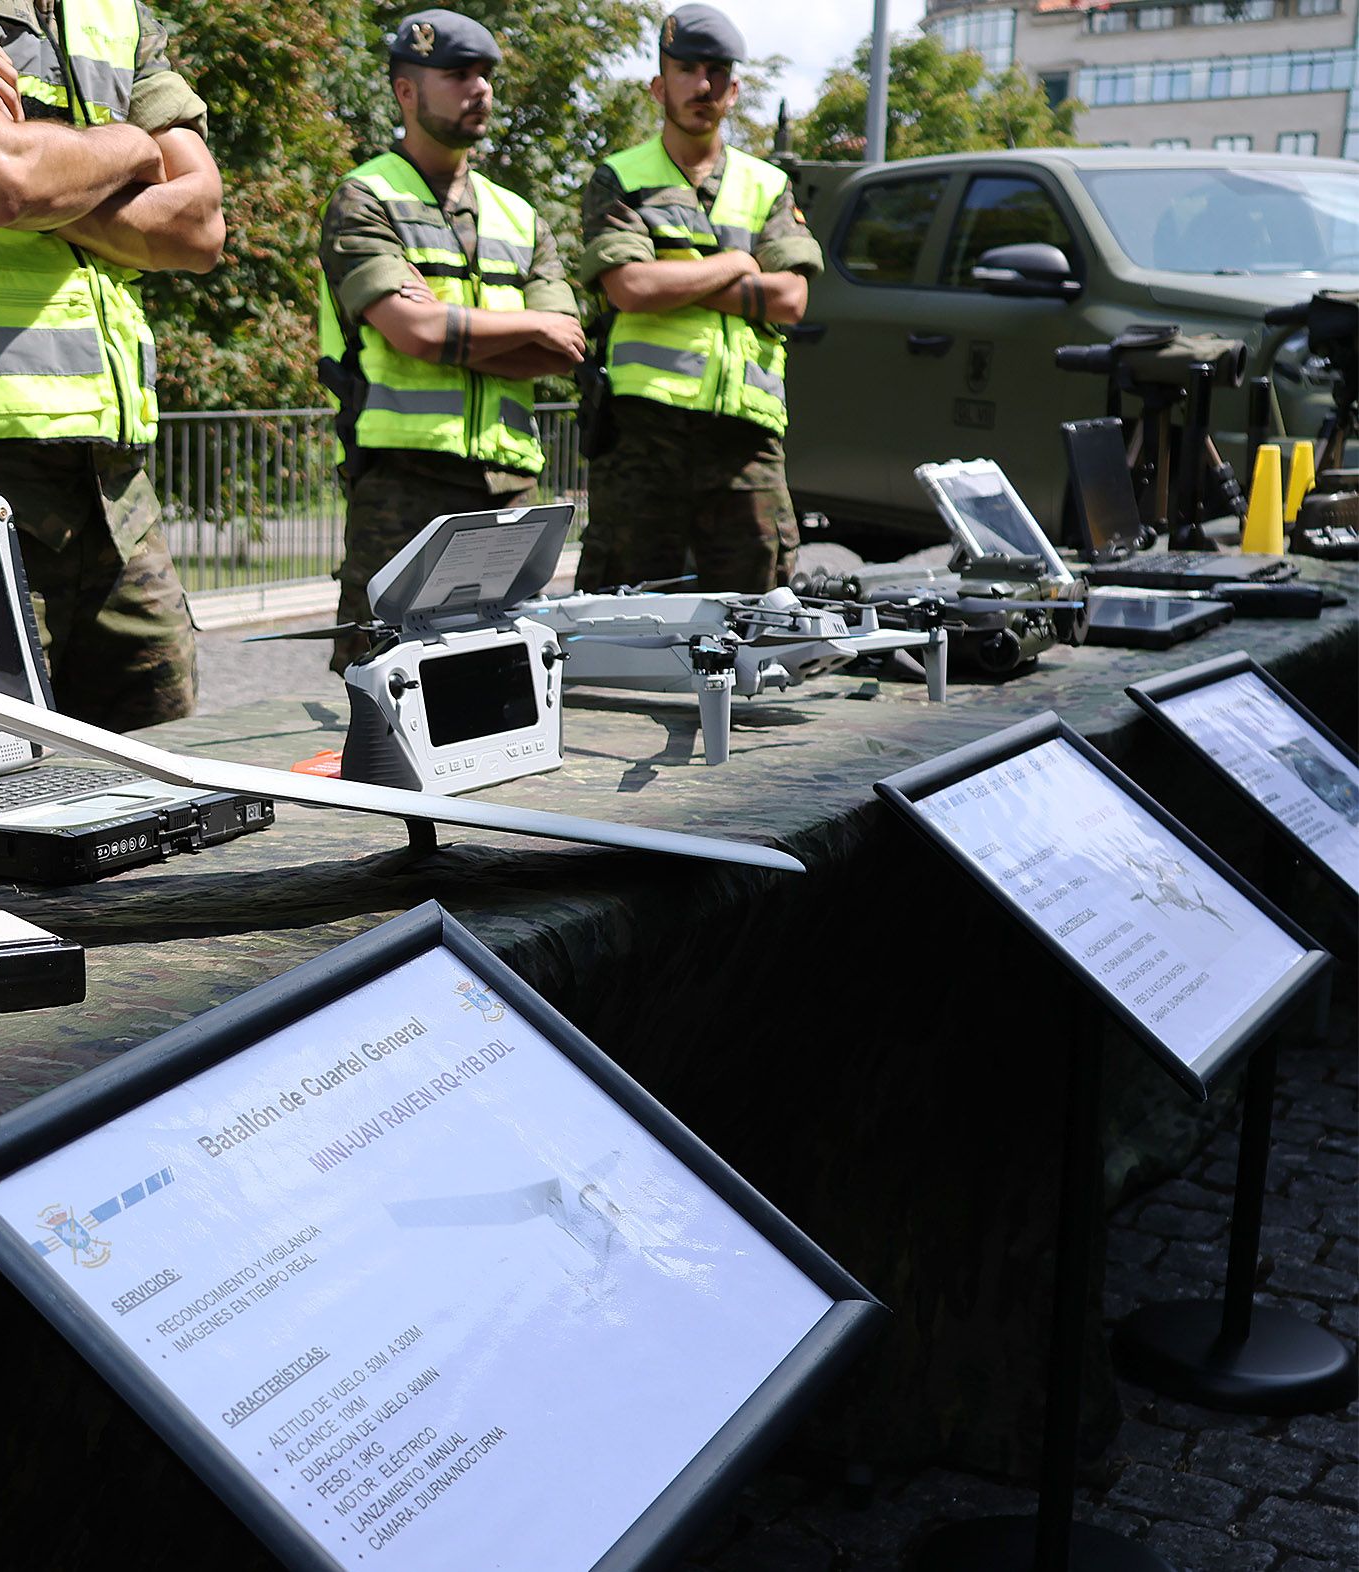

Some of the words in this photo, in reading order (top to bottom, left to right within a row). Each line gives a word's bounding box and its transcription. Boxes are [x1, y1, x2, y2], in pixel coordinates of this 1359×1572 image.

[966, 777, 1002, 799] Bataón
[197, 1108, 283, 1158] Batallón
[279, 1091, 307, 1113] de
[300, 1051, 369, 1097] Cuartel
[361, 1016, 428, 1062] General
[308, 1117, 385, 1174] MINI-UAV
[378, 1086, 438, 1129] RAVEN
[429, 1055, 486, 1096] RQ-11B
[478, 1038, 516, 1065] DDL
[111, 1268, 183, 1316] SERVICIOS:
[155, 1266, 258, 1337] RECONOCIMIENTO
[252, 1259, 266, 1272] Y
[261, 1224, 323, 1266] VIGILANCIA
[171, 1307, 234, 1354] IMÁGENES
[229, 1297, 252, 1315] EN
[247, 1270, 290, 1303] TIEMPO
[285, 1252, 318, 1277] REAL
[221, 1345, 331, 1429] CARACTERÍSTICAS:
[267, 1407, 316, 1450] ALTITUD
[311, 1395, 333, 1415] DE
[326, 1368, 370, 1402] VUELO:
[364, 1351, 391, 1373] 50M
[386, 1344, 401, 1358] A
[394, 1325, 424, 1351] 300M
[284, 1418, 342, 1468] ALCANCE:
[338, 1395, 370, 1423] 10KM
[299, 1430, 362, 1484] DURACION
[356, 1418, 377, 1438] DE
[370, 1390, 413, 1424] VUELO:
[407, 1366, 441, 1396] 90MIN
[316, 1467, 356, 1500] PESO:
[352, 1440, 385, 1471] 1,9KG
[333, 1475, 382, 1517] MOTOR:
[350, 1465, 429, 1535] LANZAMIENTO:
[422, 1431, 469, 1472] MANUAL
[367, 1504, 421, 1551] CÁMARA:
[413, 1425, 508, 1511] DIURNA/NOCTURNA
